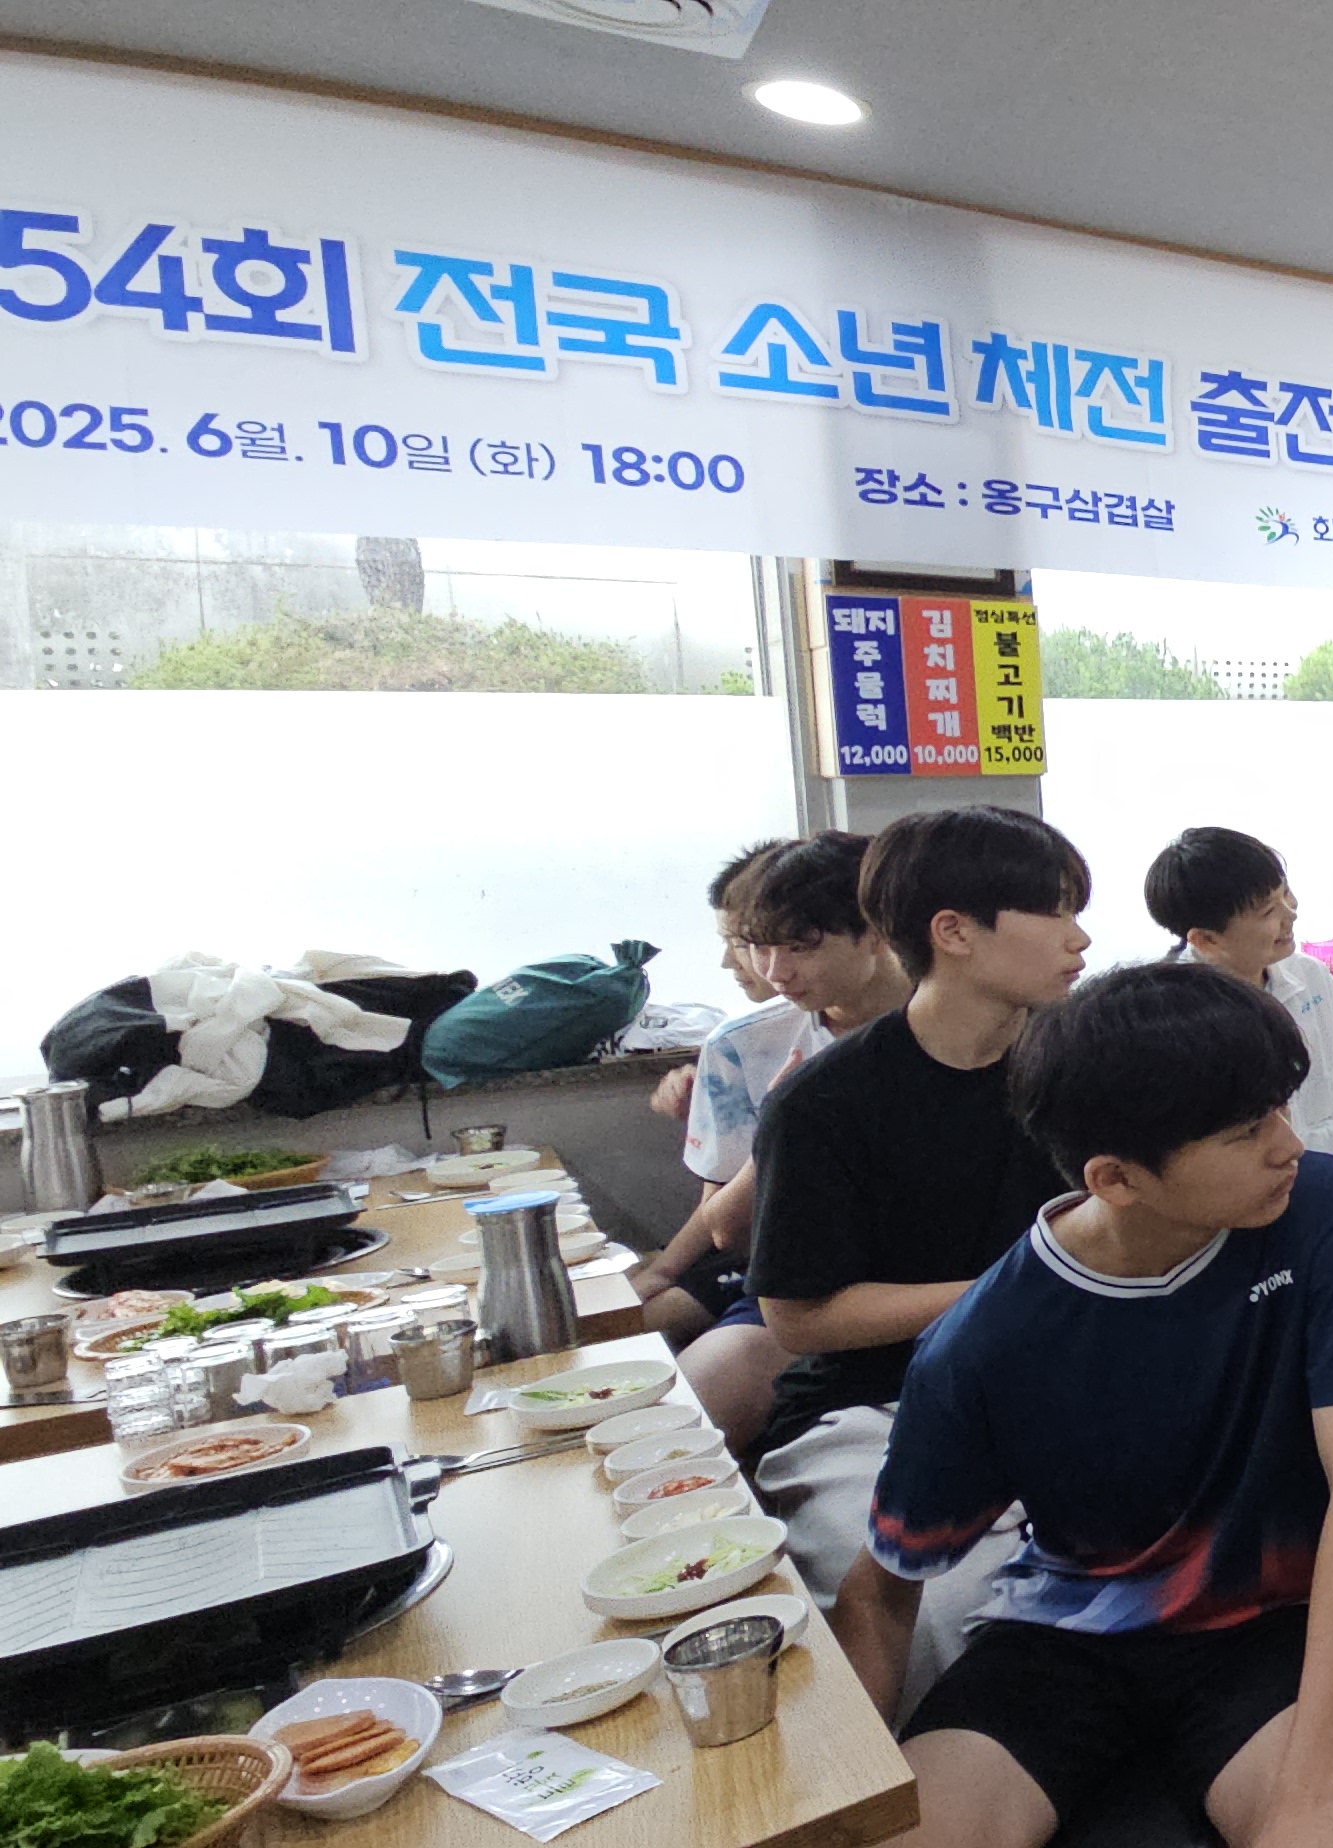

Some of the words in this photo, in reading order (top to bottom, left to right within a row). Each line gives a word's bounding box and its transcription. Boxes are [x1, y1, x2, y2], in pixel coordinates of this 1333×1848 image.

[0, 209, 356, 353] 54회
[394, 249, 681, 386] 전국
[718, 303, 950, 417] 소년
[971, 331, 1167, 447] 체전
[186, 412, 303, 462] 6월.
[318, 422, 452, 473] 10일
[469, 438, 556, 482] (화)
[581, 442, 745, 494] 18:00
[854, 467, 945, 509] 장소
[981, 479, 1176, 532] 옹구삼겹살
[832, 607, 896, 636] 돼지
[853, 640, 887, 731] 주물럭
[921, 609, 961, 738] 김치찌개
[993, 631, 1025, 719] 불고기
[840, 744, 909, 766] 12,000
[913, 744, 979, 764] 10,000
[983, 746, 1044, 763] 15,000
[991, 723, 1036, 744] 백반
